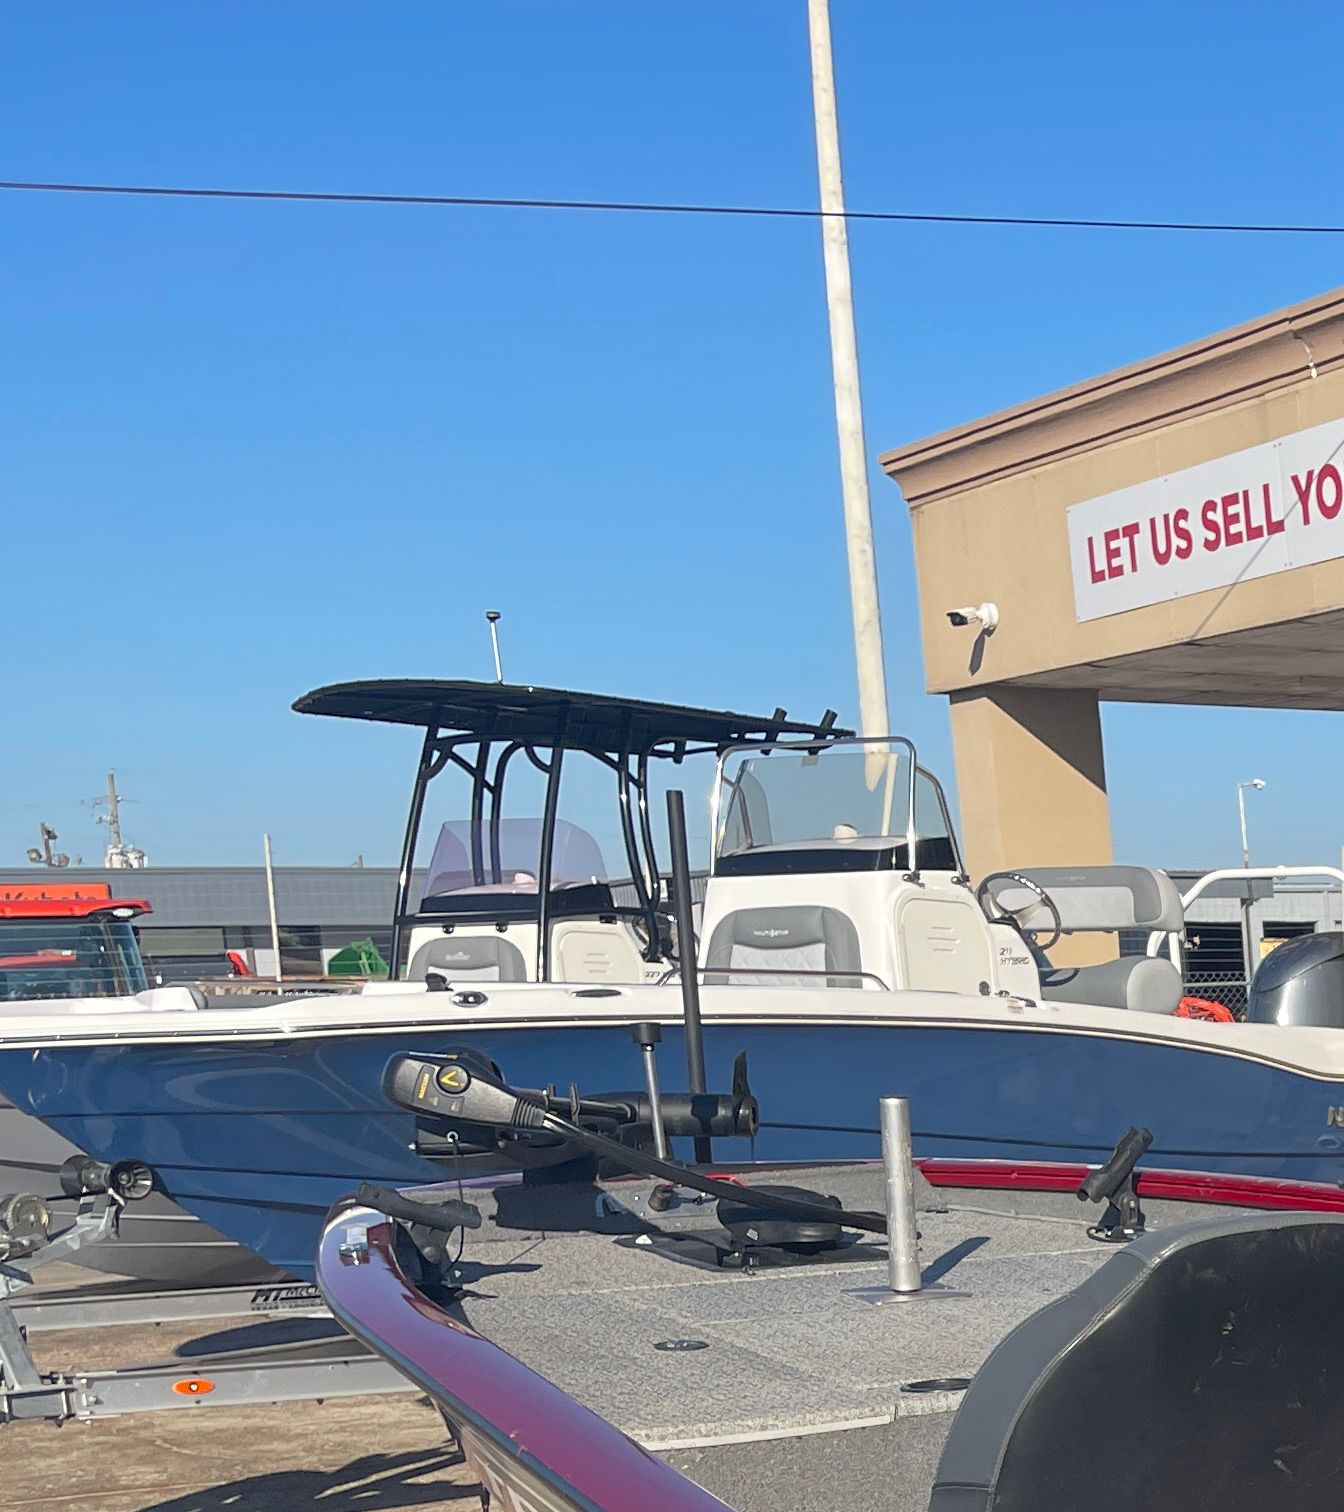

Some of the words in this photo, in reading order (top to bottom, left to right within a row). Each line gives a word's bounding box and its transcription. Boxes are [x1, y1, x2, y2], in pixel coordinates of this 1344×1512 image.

[1087, 521, 1140, 583] LET
[1149, 508, 1193, 566] US
[1201, 483, 1286, 552] SELL
